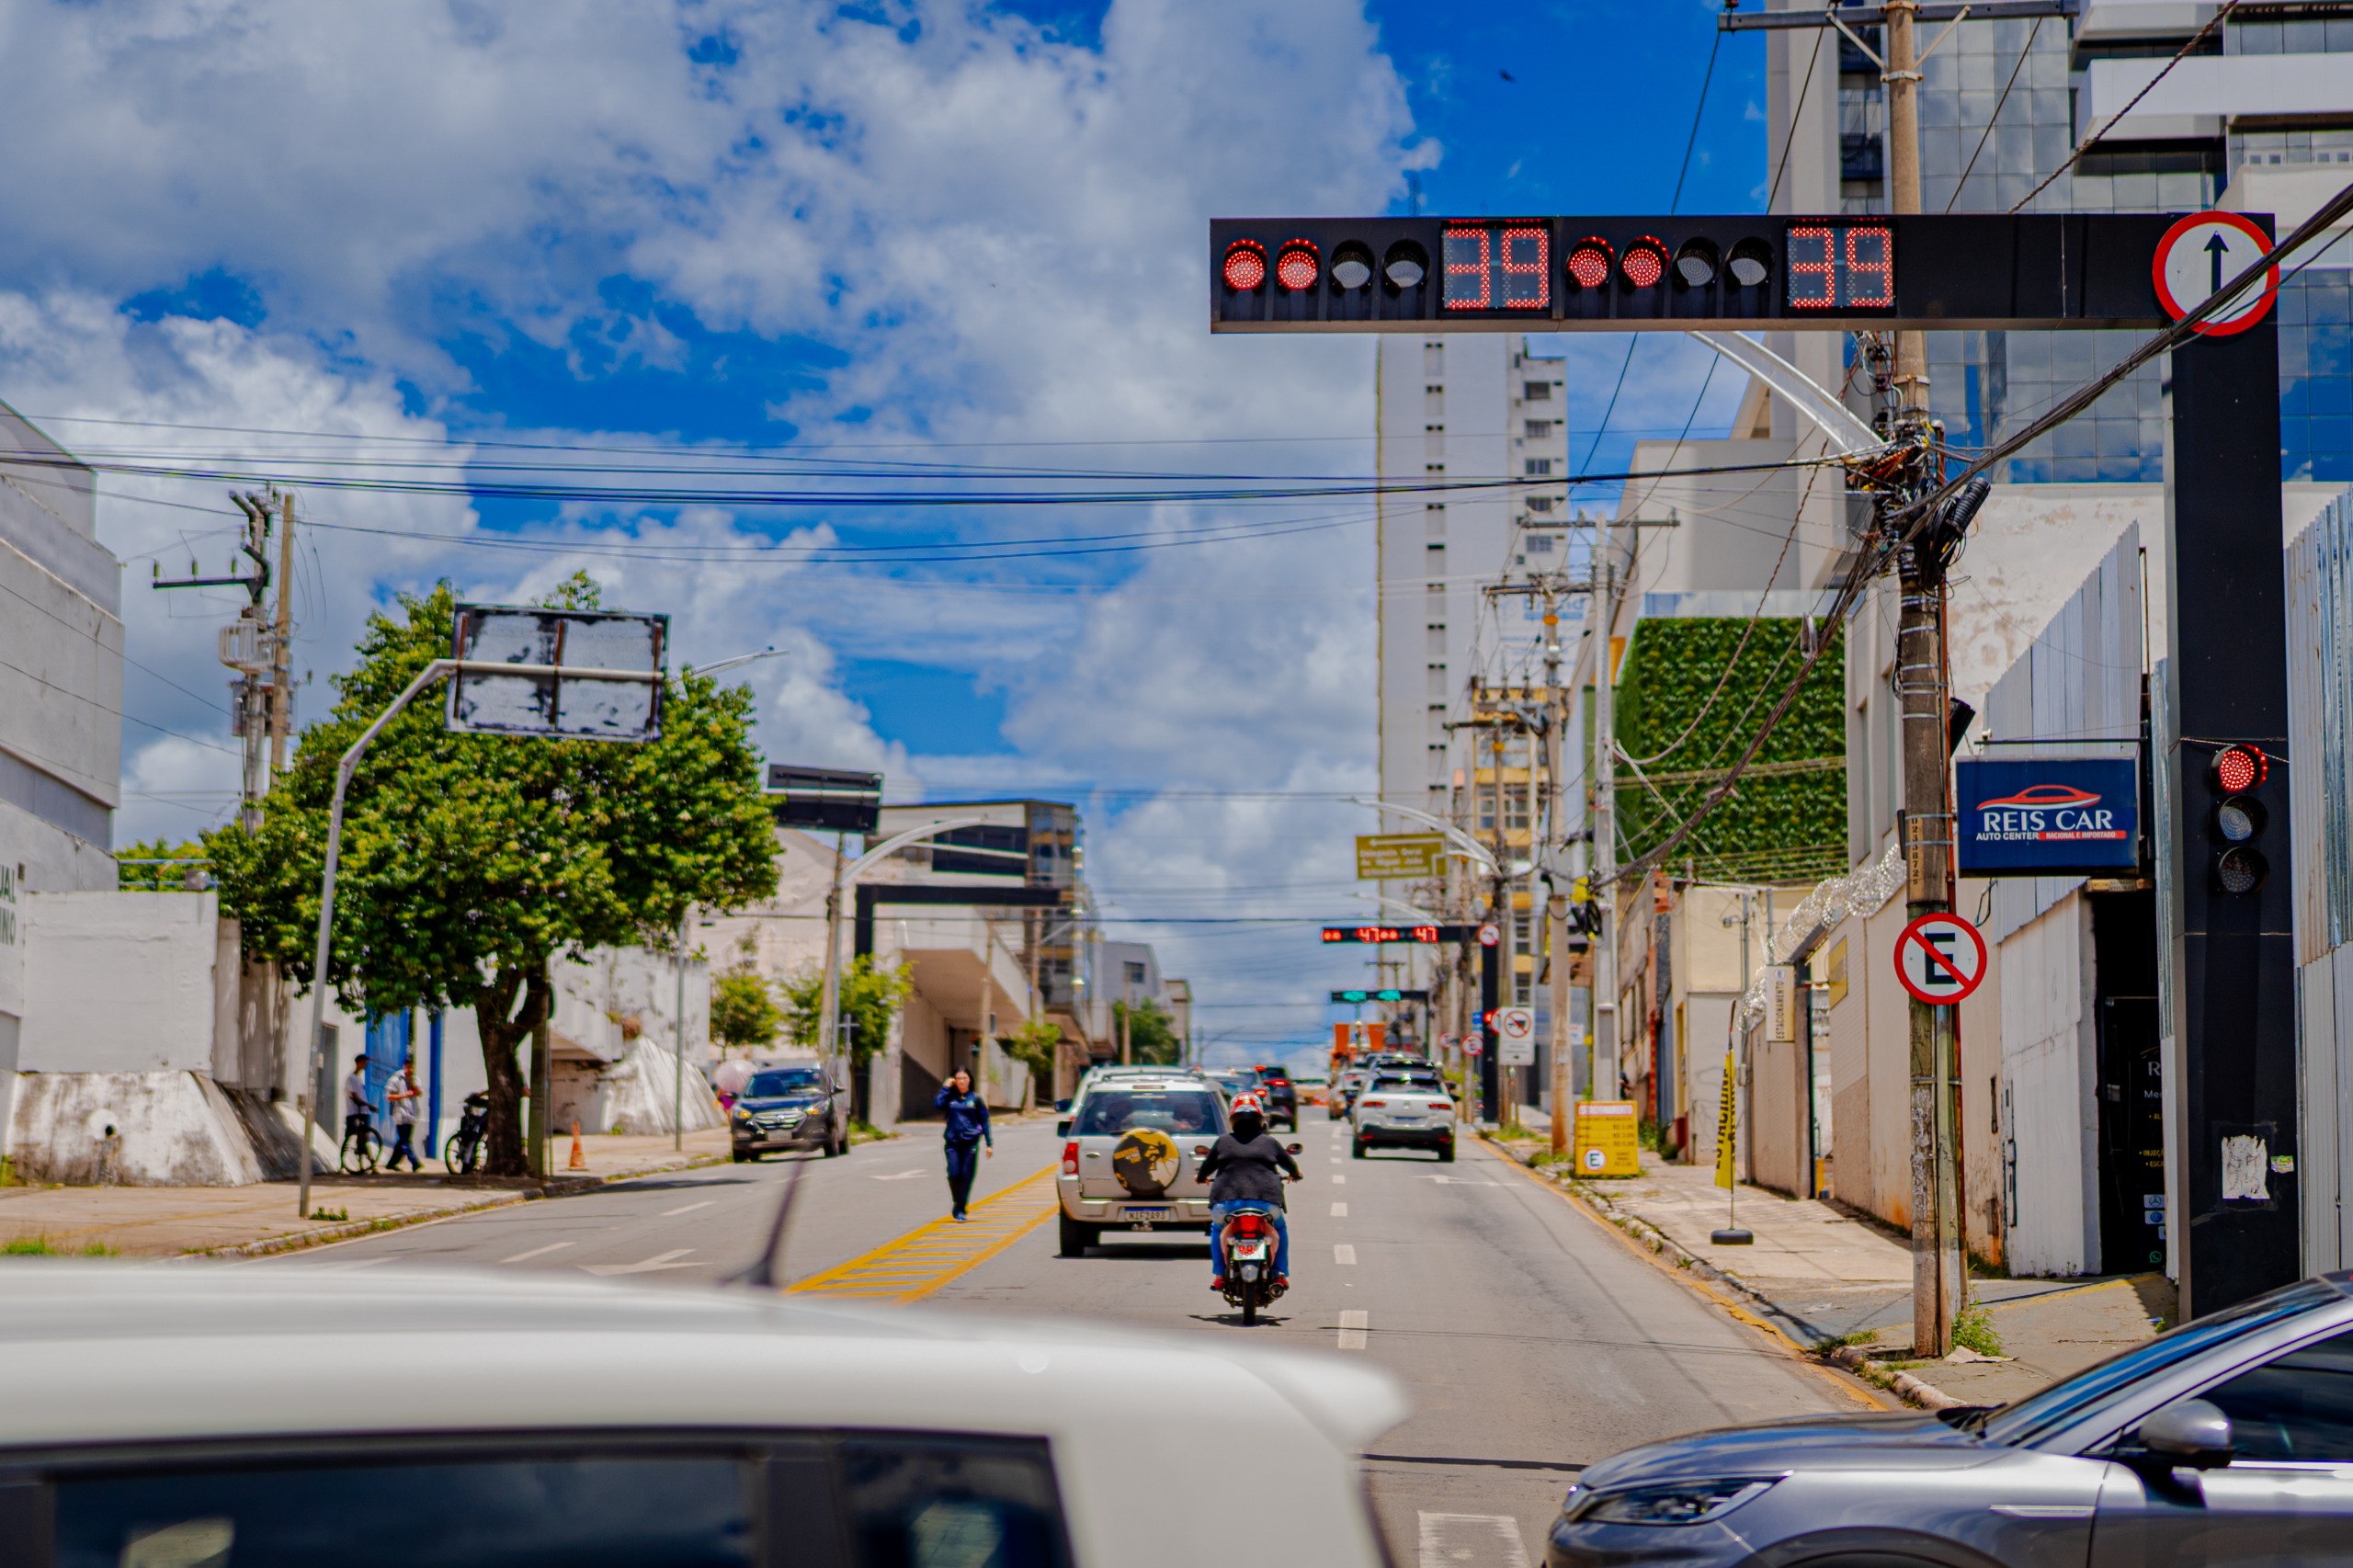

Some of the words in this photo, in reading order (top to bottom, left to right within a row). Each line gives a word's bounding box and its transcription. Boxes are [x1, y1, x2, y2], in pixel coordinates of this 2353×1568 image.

[1447, 228, 1550, 309] 39
[1791, 227, 1893, 308] 39
[1984, 810, 2046, 832] REIS
[2055, 809, 2113, 831] CAR
[1976, 831, 2001, 841] AUTO
[2002, 831, 2039, 841] CENTER
[2046, 831, 2075, 839] NACIONAL
[2082, 831, 2116, 839] IMPORTADO
[1357, 926, 1380, 943] 47
[1414, 926, 1438, 943] 47
[1925, 932, 1957, 985] E
[1776, 981, 1784, 1040] ESTACIONAMENTO
[1590, 1153, 1600, 1166] E
